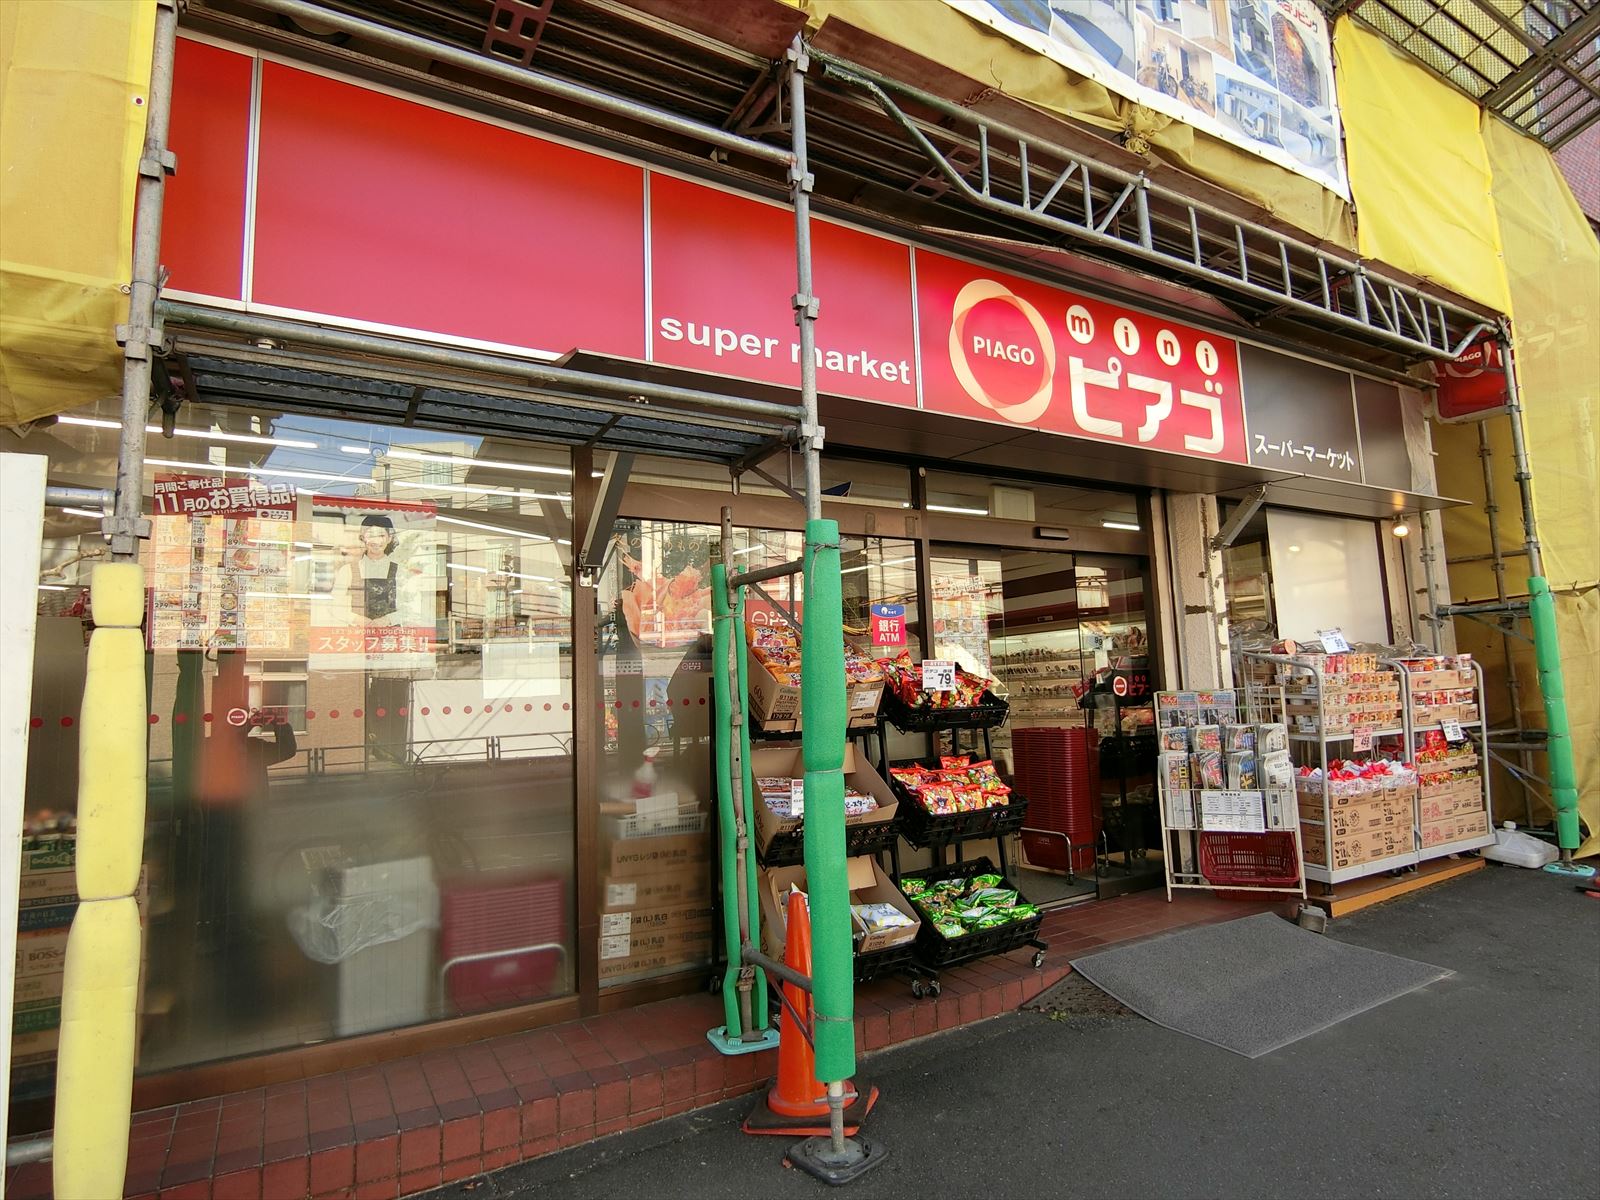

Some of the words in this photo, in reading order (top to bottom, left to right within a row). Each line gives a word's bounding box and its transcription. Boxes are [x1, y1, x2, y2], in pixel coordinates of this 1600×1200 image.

[659, 317, 779, 357] super
[973, 335, 1035, 366] PIAGO
[1068, 309, 1214, 368] mini
[1068, 355, 1224, 455] ピアゴ
[1254, 433, 1355, 472] スーパーマーケット
[878, 619, 900, 633] 銀行
[879, 633, 900, 642] ATM
[937, 673, 952, 685] 79
